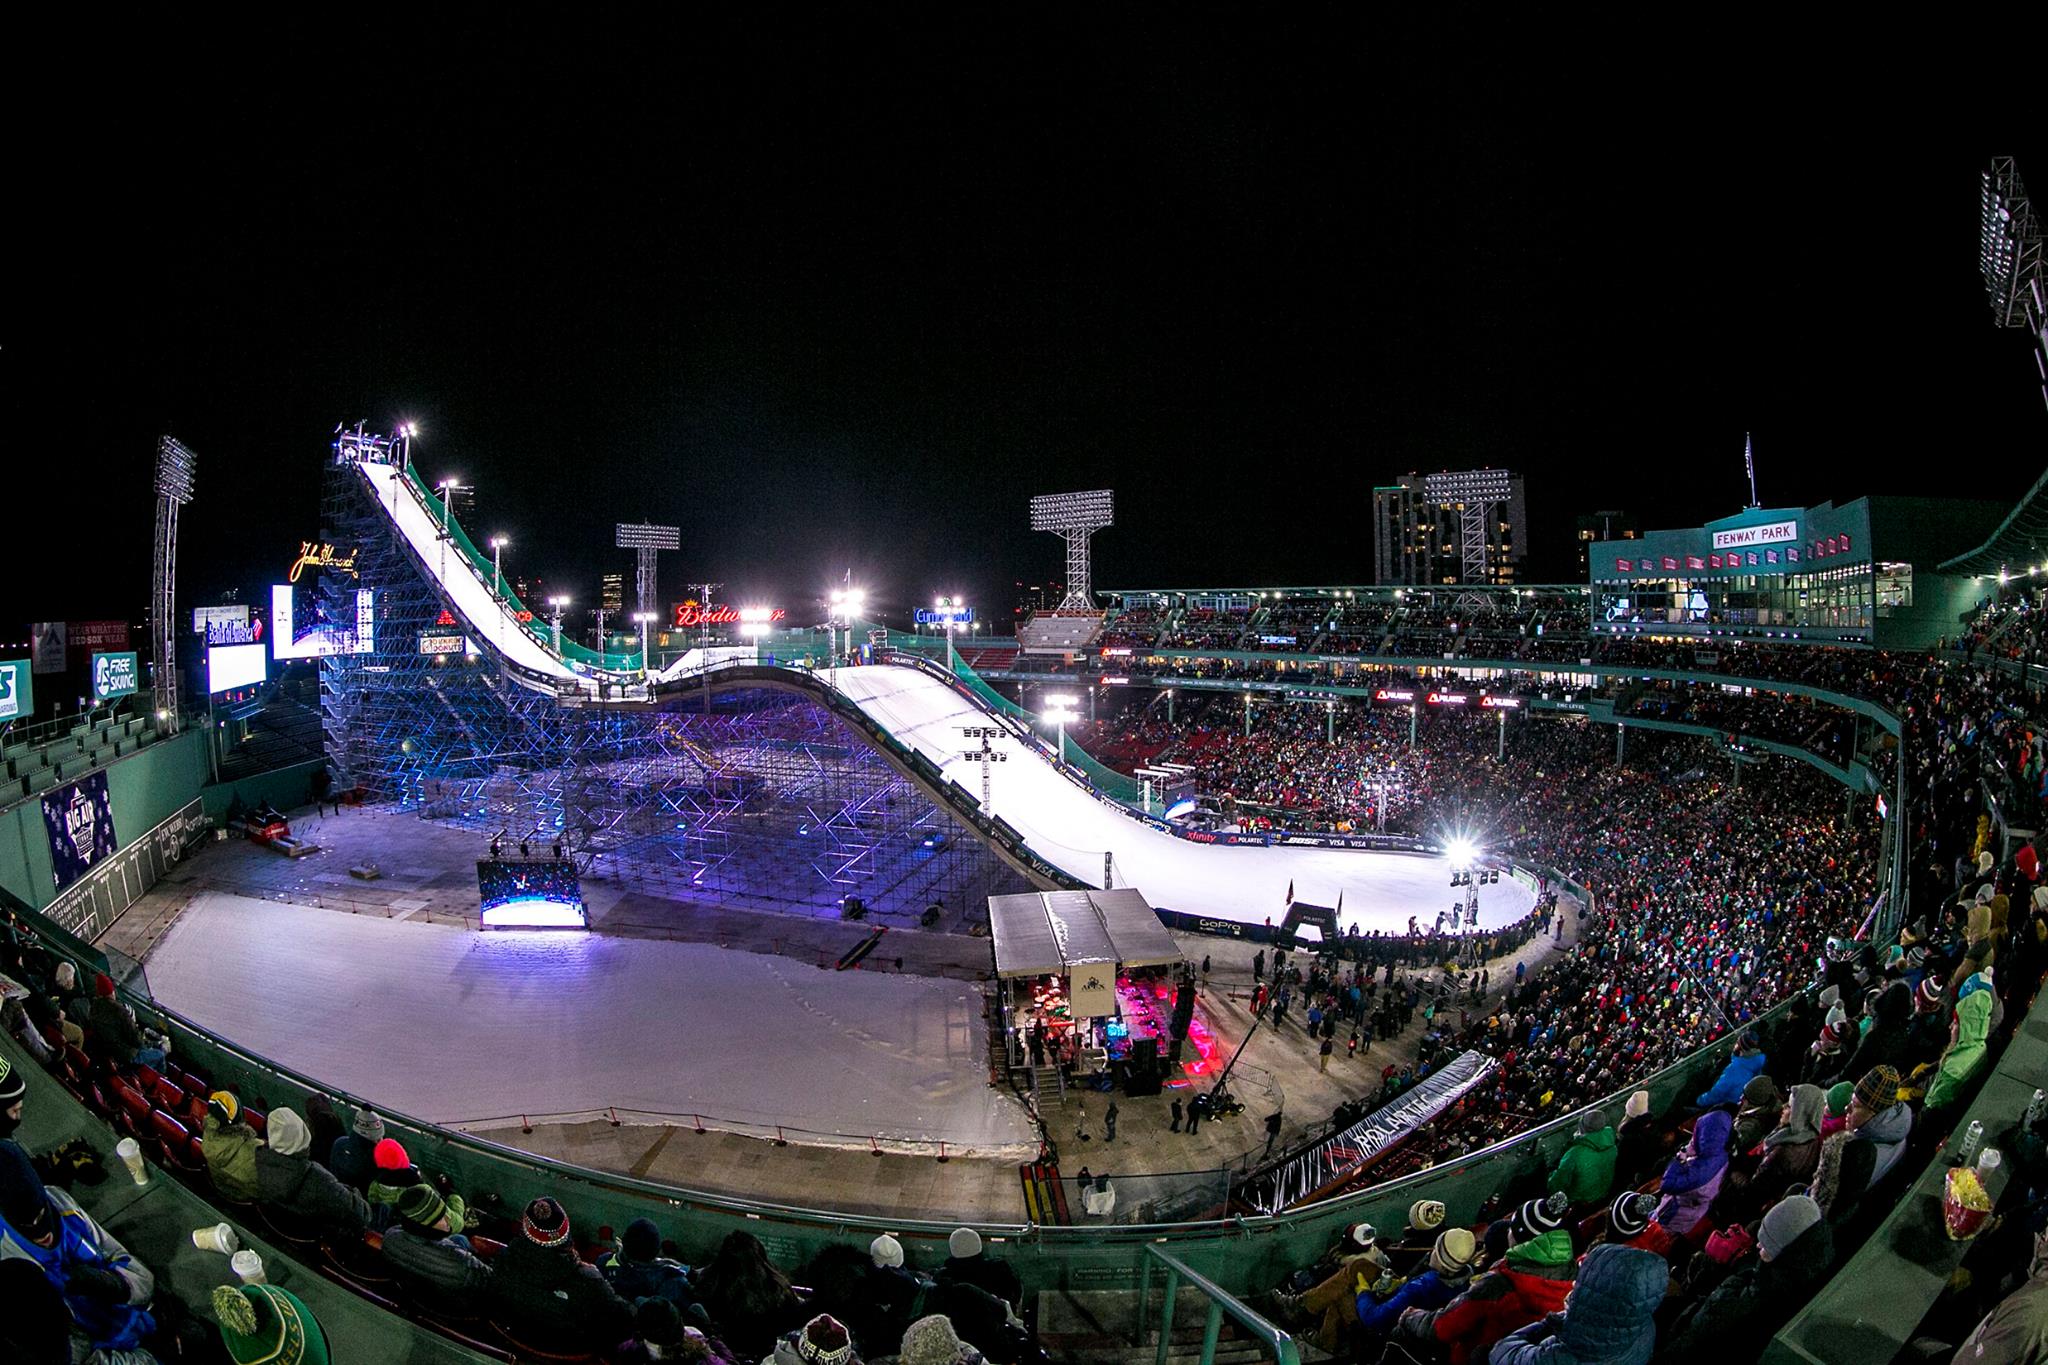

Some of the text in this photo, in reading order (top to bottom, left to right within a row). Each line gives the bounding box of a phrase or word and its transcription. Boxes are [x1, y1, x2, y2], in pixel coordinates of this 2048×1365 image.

[1717, 525, 1791, 545] FENWAY PARK
[86, 635, 103, 644] SOX
[110, 658, 131, 673] FREE
[65, 808, 81, 837] BIG
[80, 800, 96, 825] AIR
[1142, 816, 1171, 831] GoPro
[1187, 832, 1216, 843] xfinity
[1285, 836, 1322, 845] BOSE
[1031, 859, 1056, 878] VISA
[1200, 919, 1241, 931] GoPro
[1353, 1094, 1431, 1154] POLARTEC
